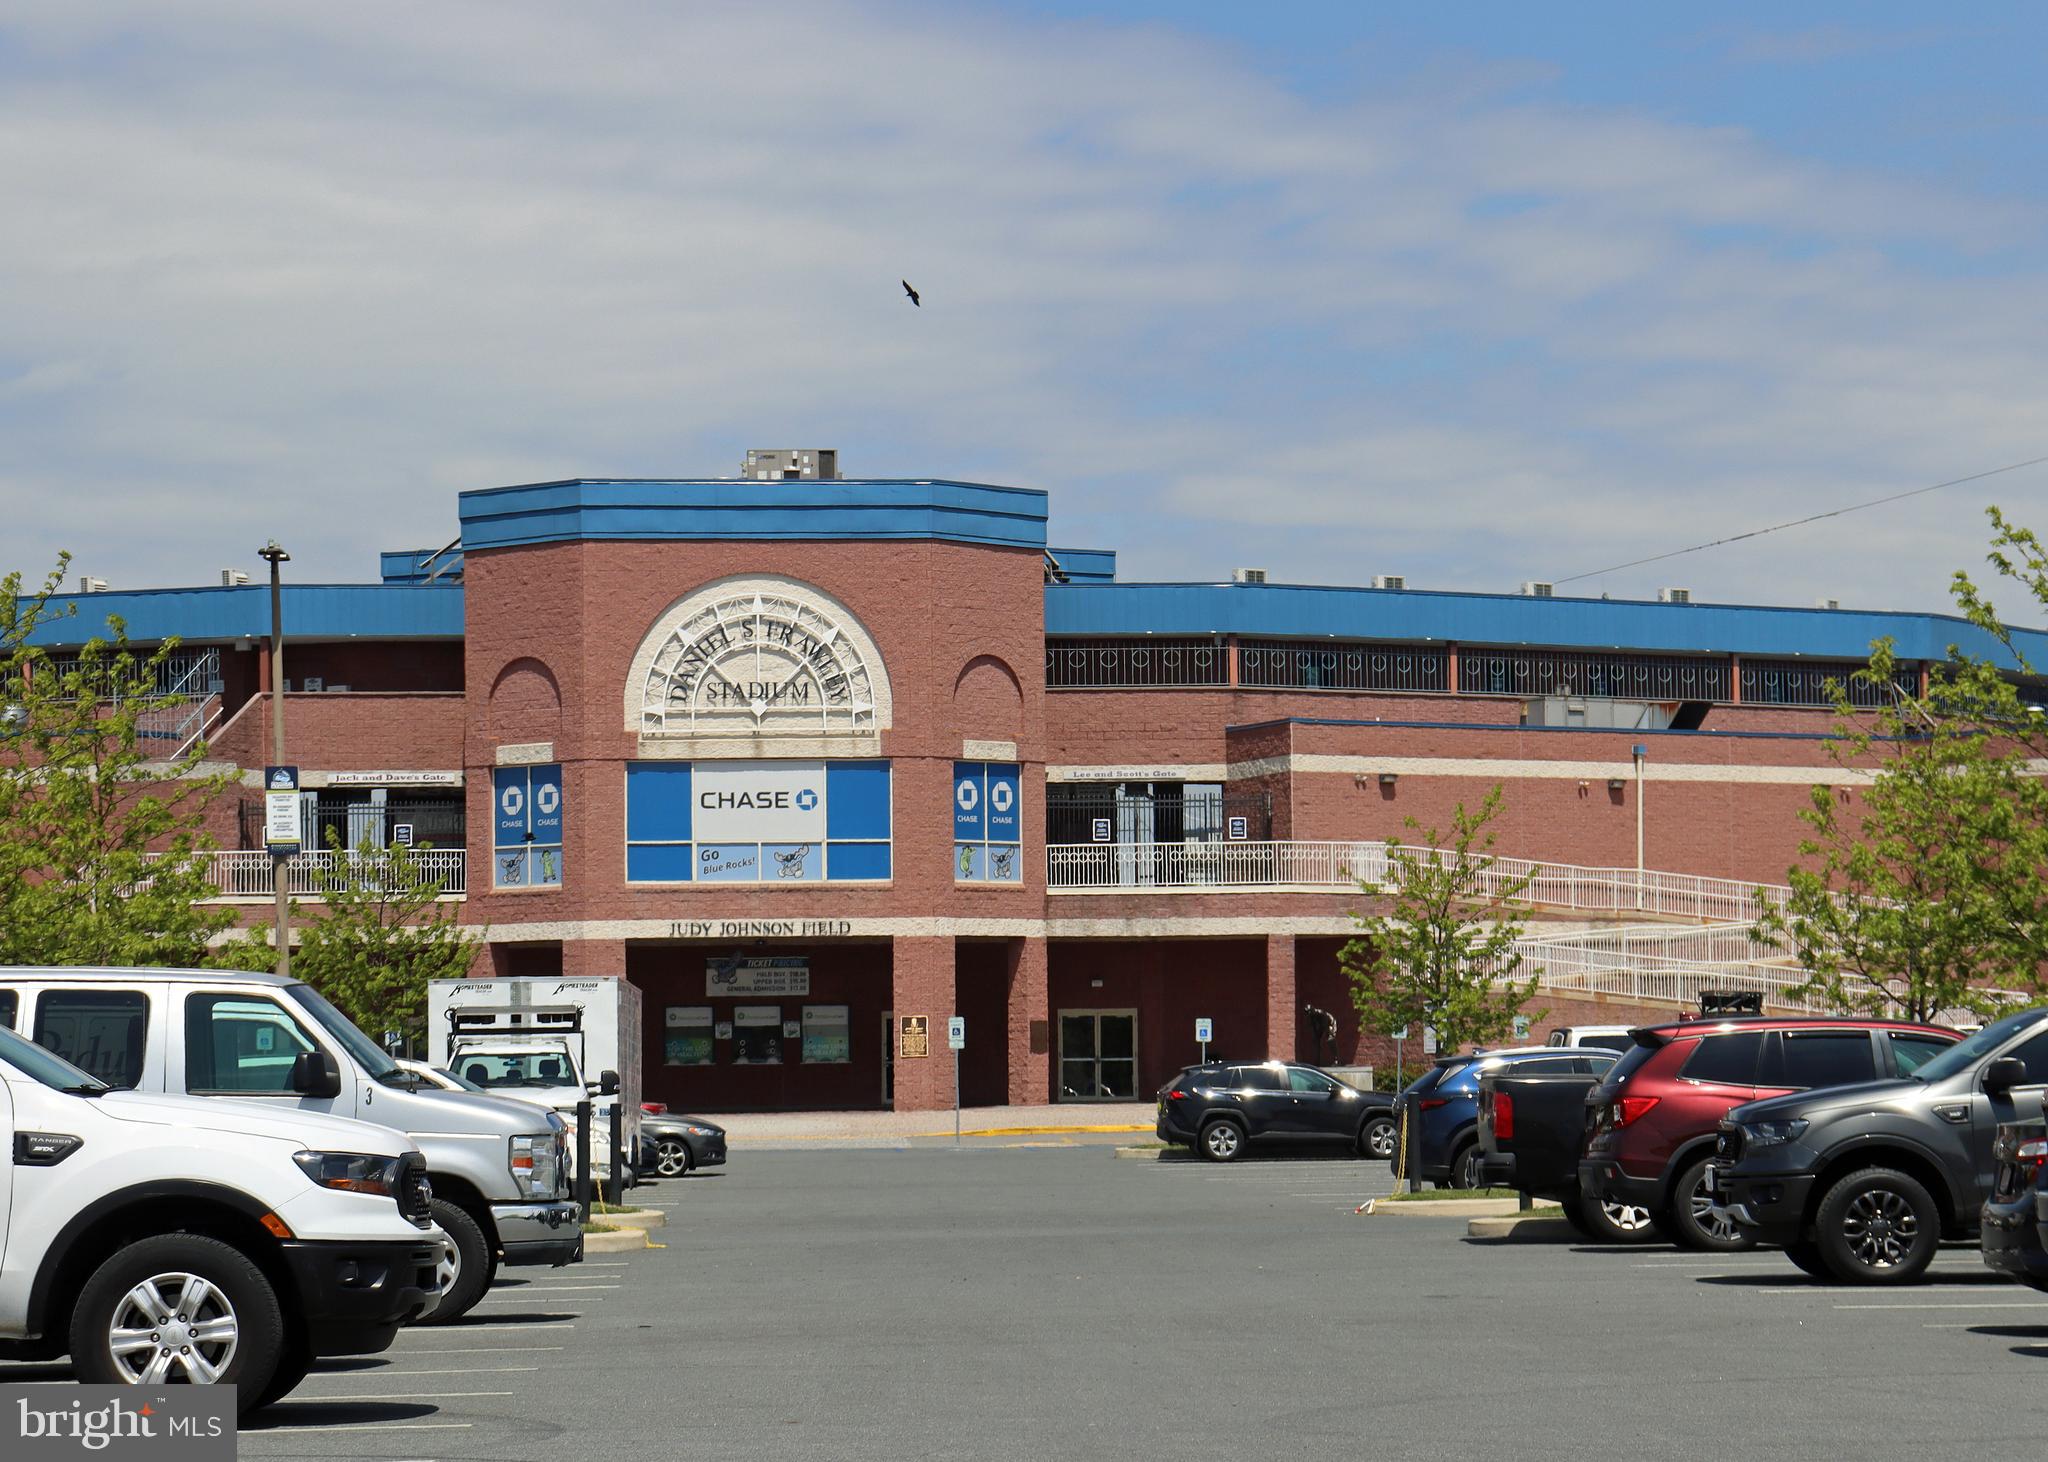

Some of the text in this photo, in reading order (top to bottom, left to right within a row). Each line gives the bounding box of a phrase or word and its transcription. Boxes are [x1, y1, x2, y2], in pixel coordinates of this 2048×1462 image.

[669, 622, 736, 702] DANIEL
[767, 621, 848, 702] FRAWLEY
[706, 681, 809, 699] STADIUM
[336, 774, 359, 782] Jack
[422, 773, 446, 781] Gate
[701, 791, 790, 809] CHASE
[501, 820, 523, 828] CHASE
[537, 818, 560, 826] CHASE
[957, 815, 978, 823] CHASE
[992, 816, 1013, 824] CHASE
[701, 849, 720, 862] Go
[703, 856, 756, 875] Blue Rocks!
[669, 920, 851, 937] JUDY JOHNSON FIELD
[747, 959, 773, 968] TICKET
[365, 1087, 373, 1106] 3
[30, 1137, 72, 1145] RANGER
